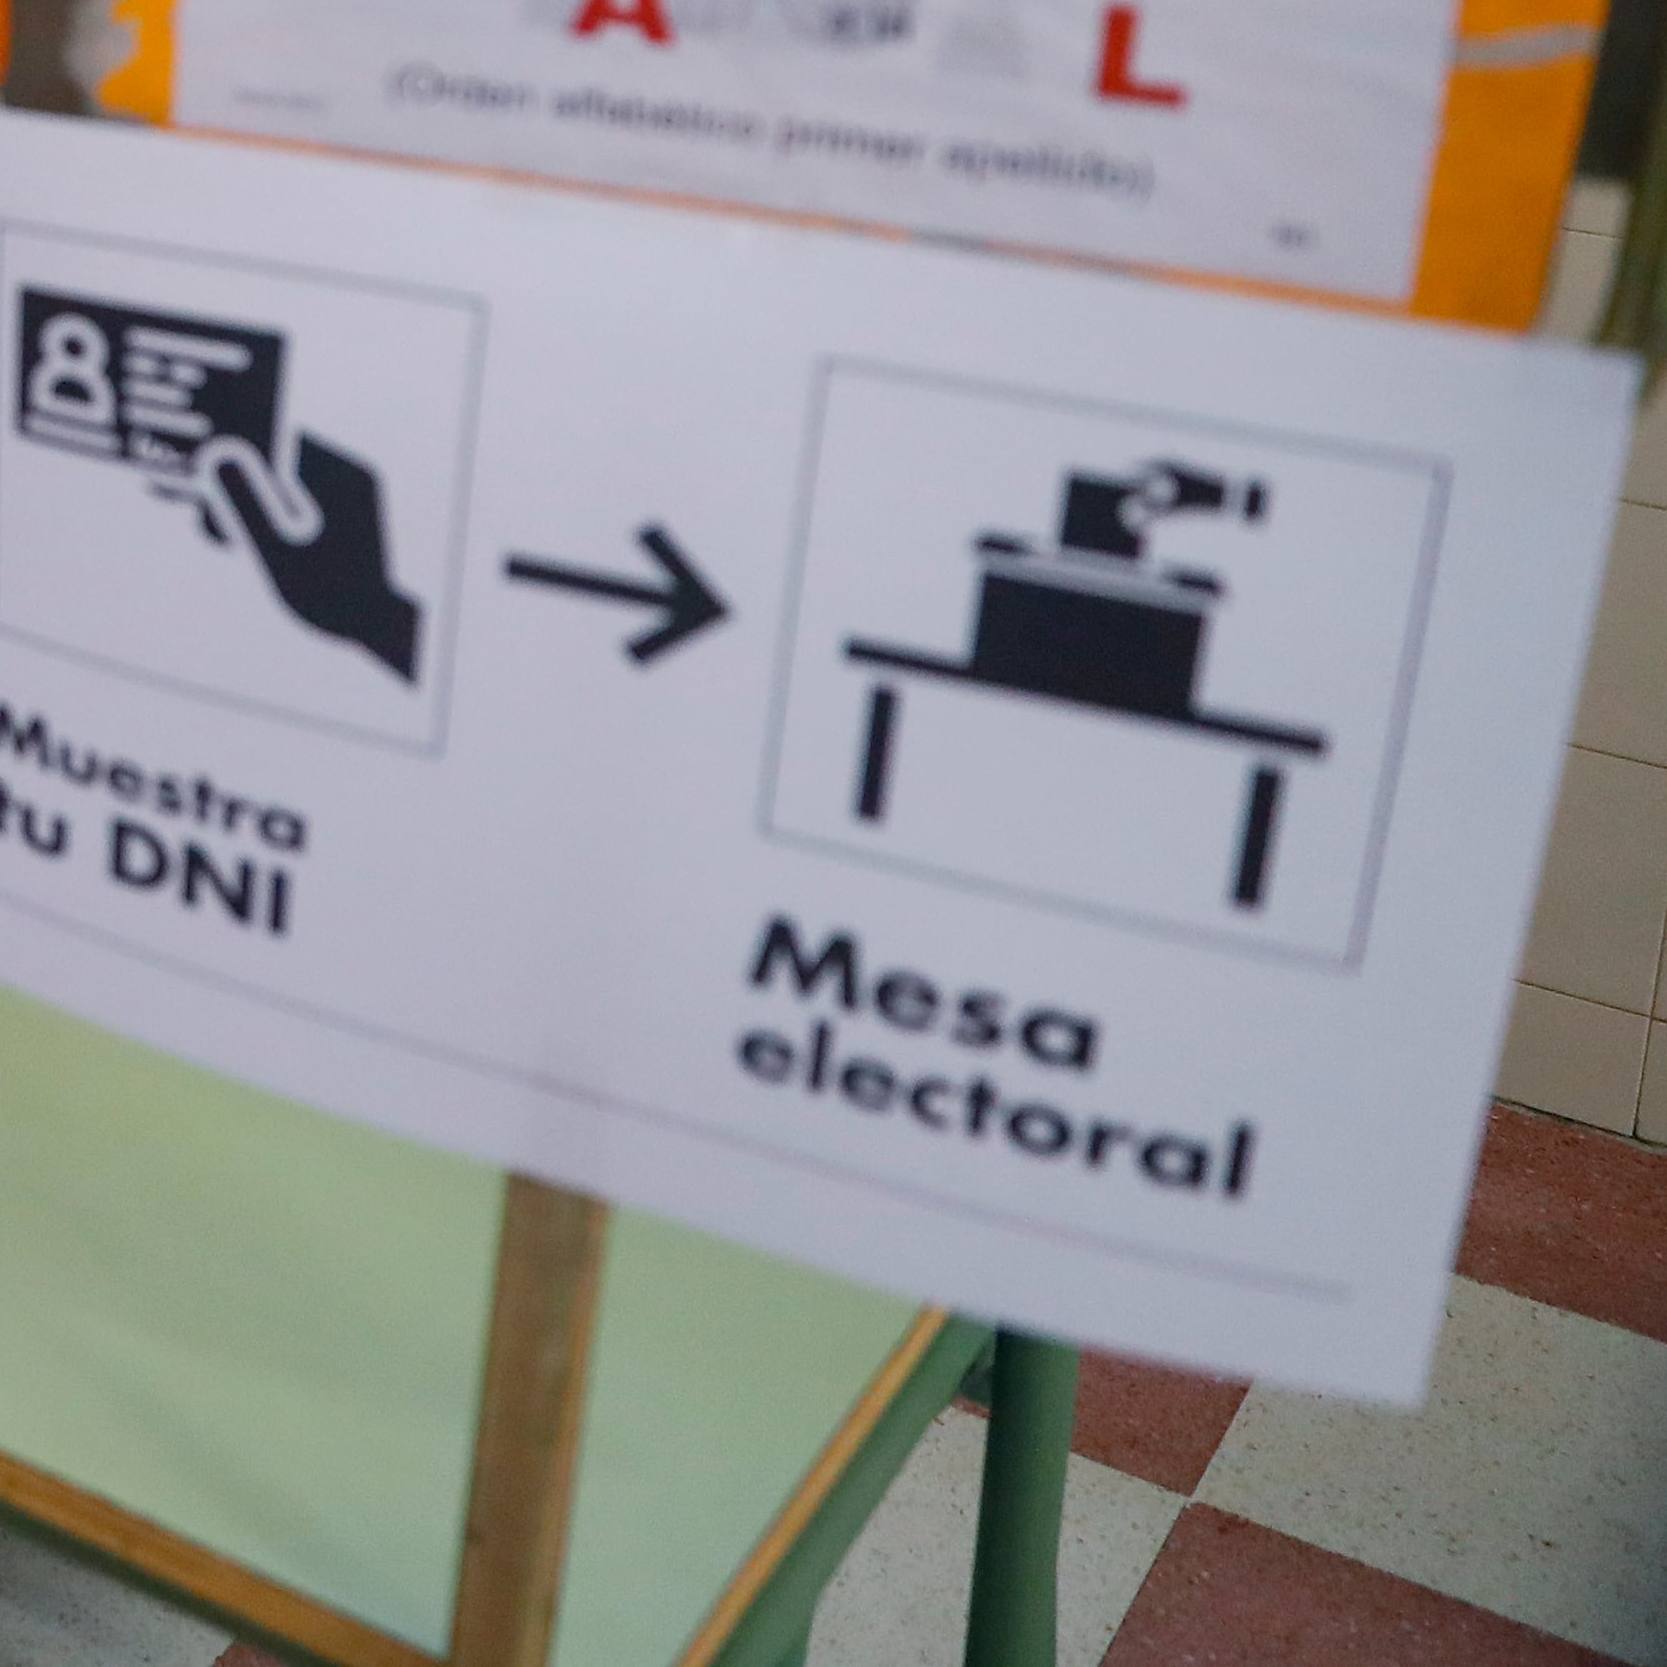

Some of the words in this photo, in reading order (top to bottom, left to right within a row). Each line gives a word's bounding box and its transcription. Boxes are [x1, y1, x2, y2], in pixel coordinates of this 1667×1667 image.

[1094, 1, 1187, 110] L
[109, 818, 291, 936] DNI
[747, 913, 1103, 1073] Mesa
[735, 1019, 1259, 1197] electoral
